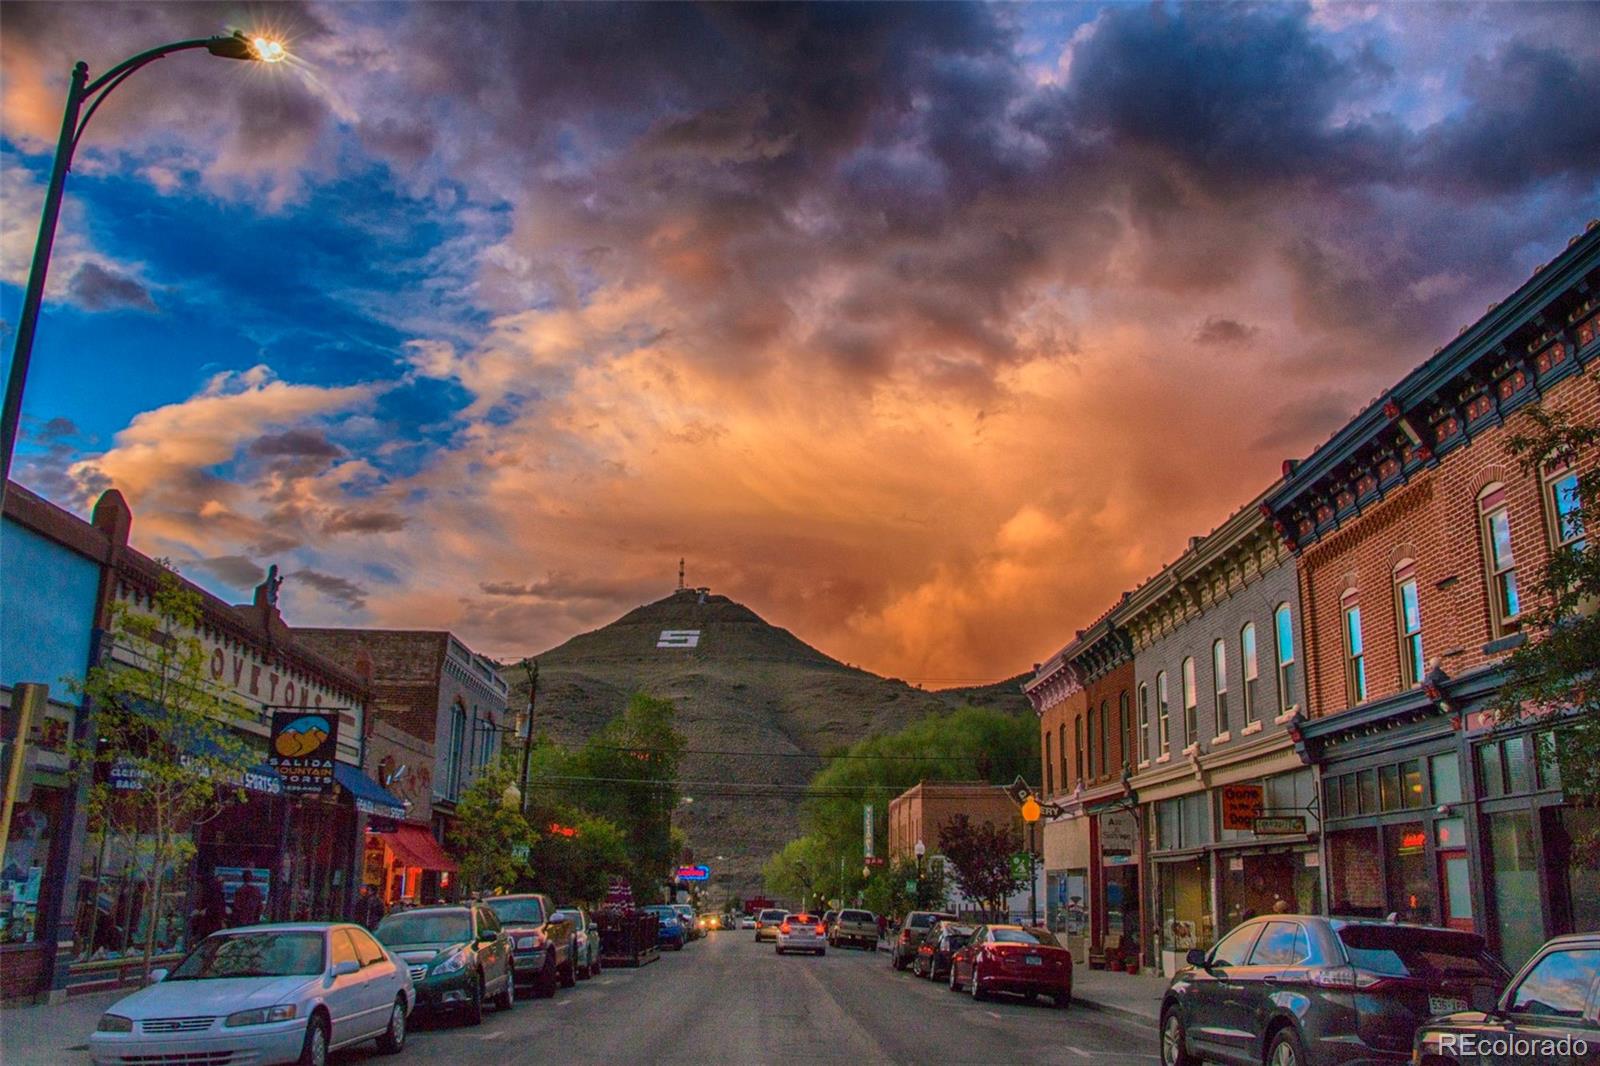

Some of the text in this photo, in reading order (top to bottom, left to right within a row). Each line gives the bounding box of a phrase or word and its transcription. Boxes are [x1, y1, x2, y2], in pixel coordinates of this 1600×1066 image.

[656, 630, 700, 648] S
[270, 758, 332, 768] SALIDA
[275, 767, 332, 776] OUNTAIN
[281, 775, 332, 784] PORTS
